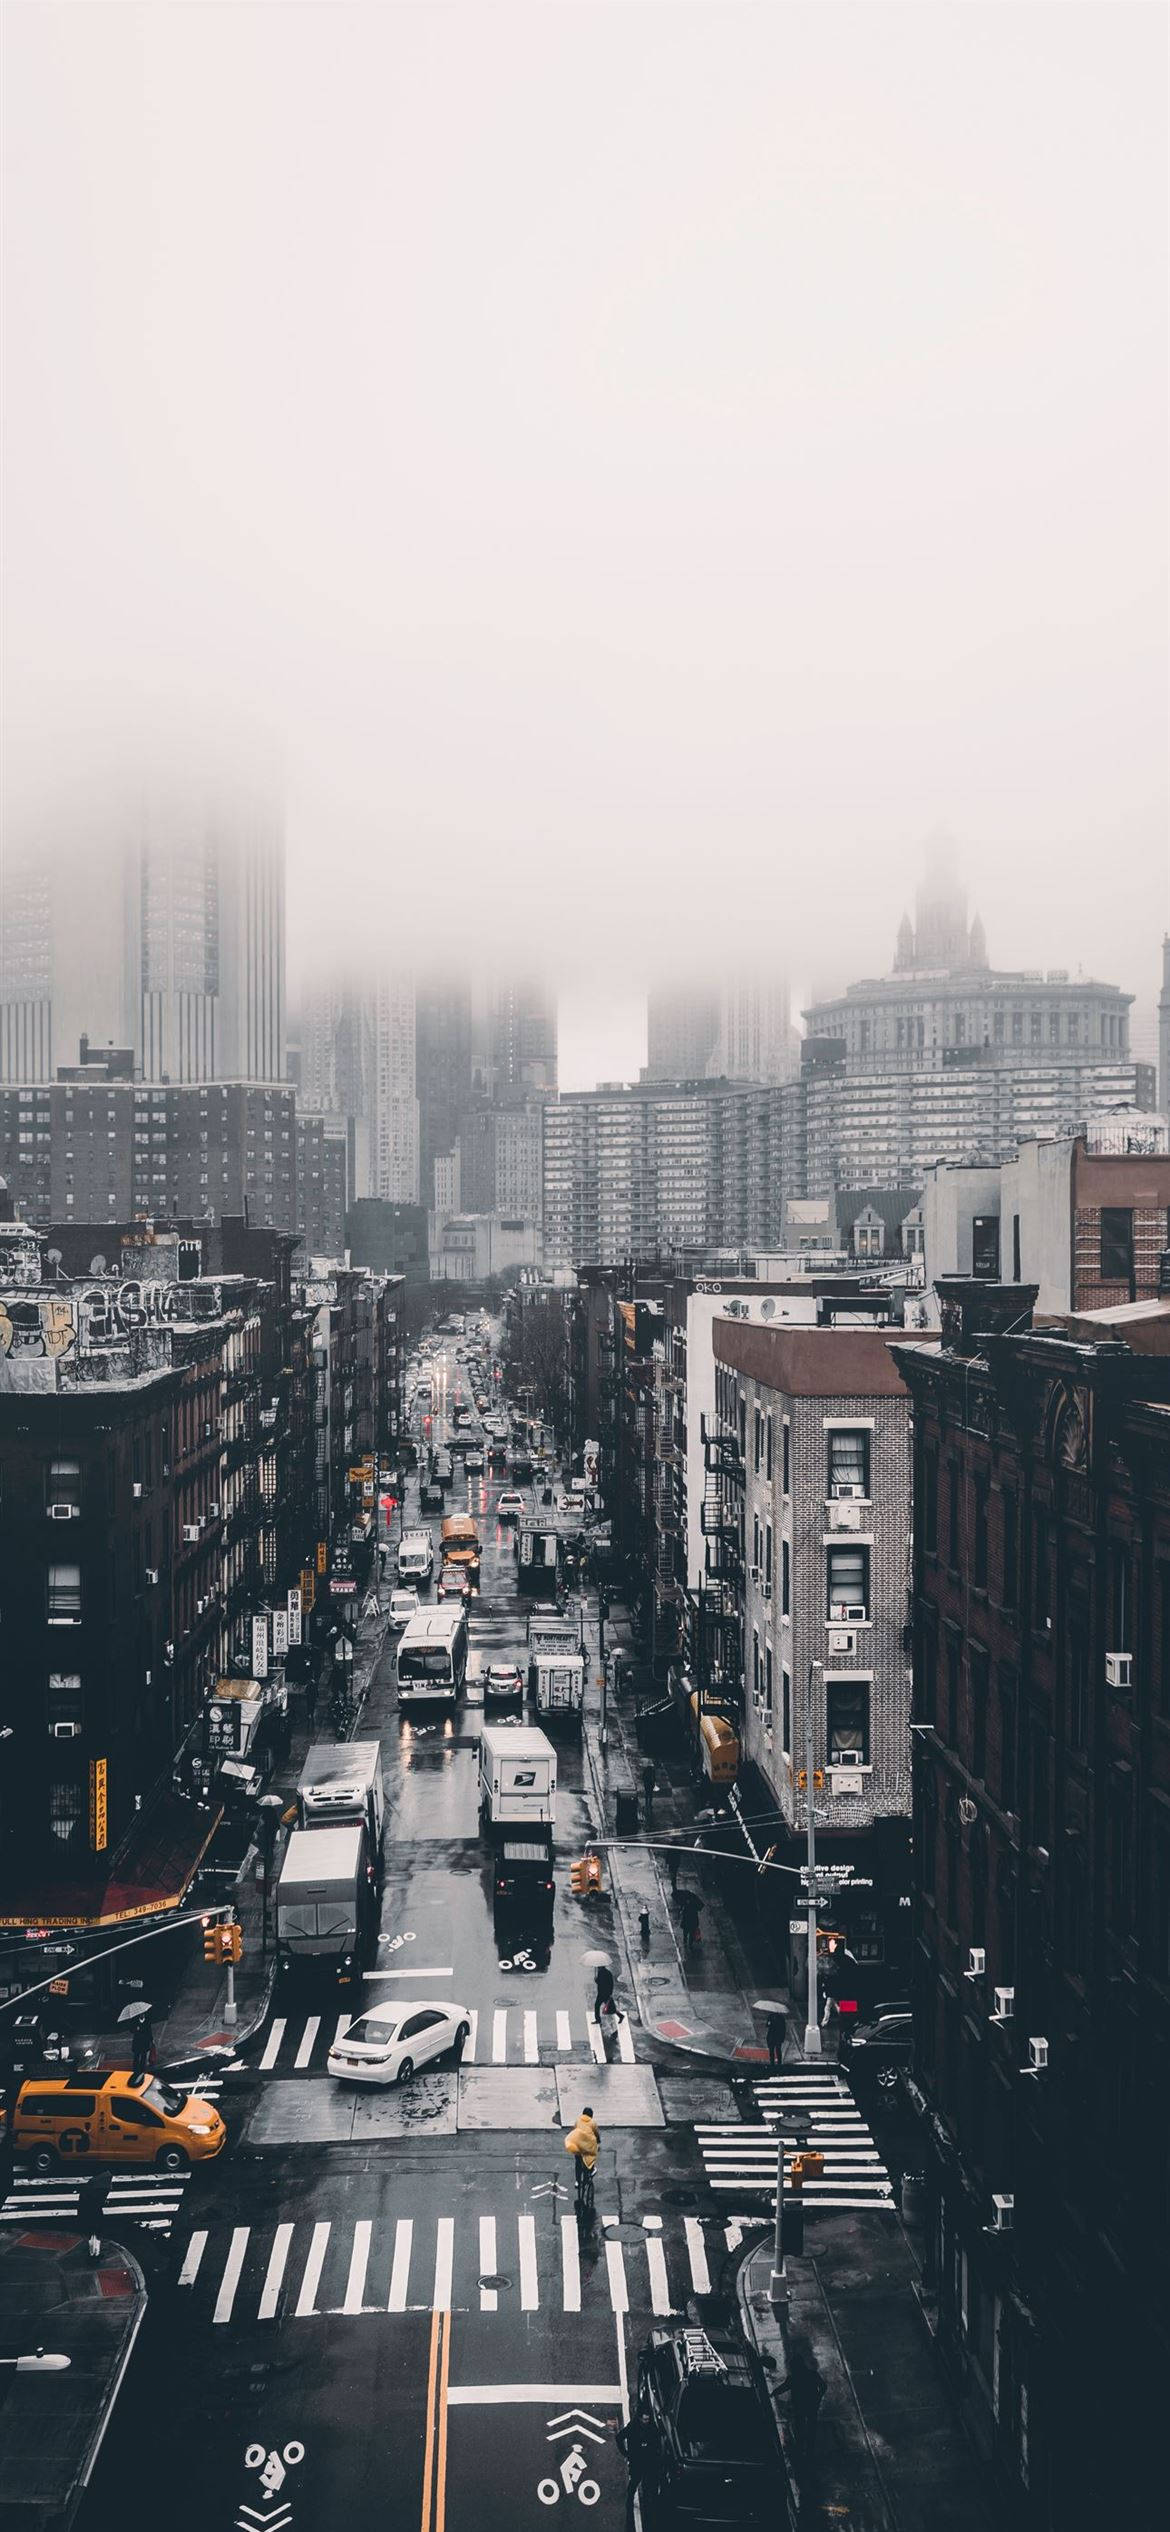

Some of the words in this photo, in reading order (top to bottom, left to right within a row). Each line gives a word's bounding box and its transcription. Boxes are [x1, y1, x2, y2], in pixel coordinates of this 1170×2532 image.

[695, 1282, 721, 1293] OKO
[851, 1879, 874, 1887] printing
[42, 1917, 79, 1926] TRADING
